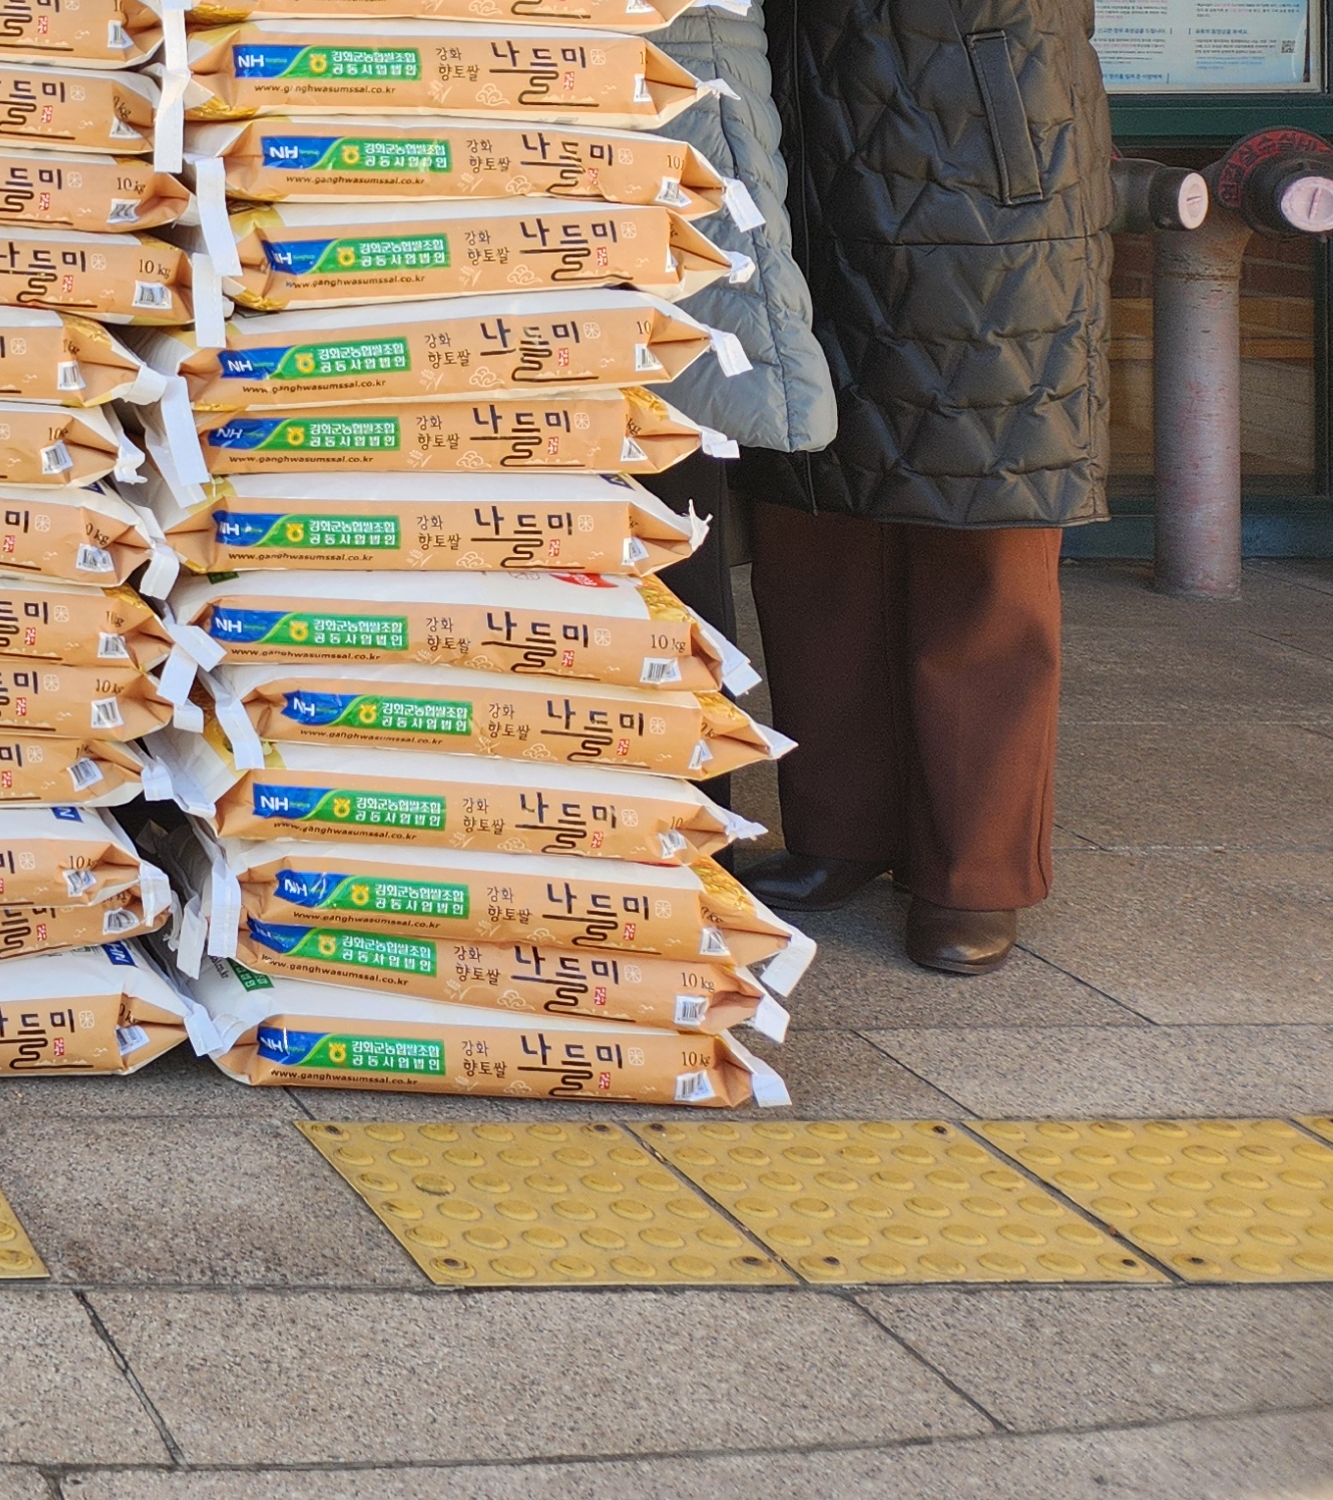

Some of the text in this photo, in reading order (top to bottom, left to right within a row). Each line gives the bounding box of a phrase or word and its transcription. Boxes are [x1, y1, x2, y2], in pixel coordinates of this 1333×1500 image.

[216, 621, 242, 633] NH
[426, 617, 453, 632] 강화
[314, 631, 403, 648] 공동사업법인
[427, 635, 470, 654] 향토쌀
[232, 648, 381, 662] www.ganghwasumssal.co.kr
[69, 855, 84, 868] 10
